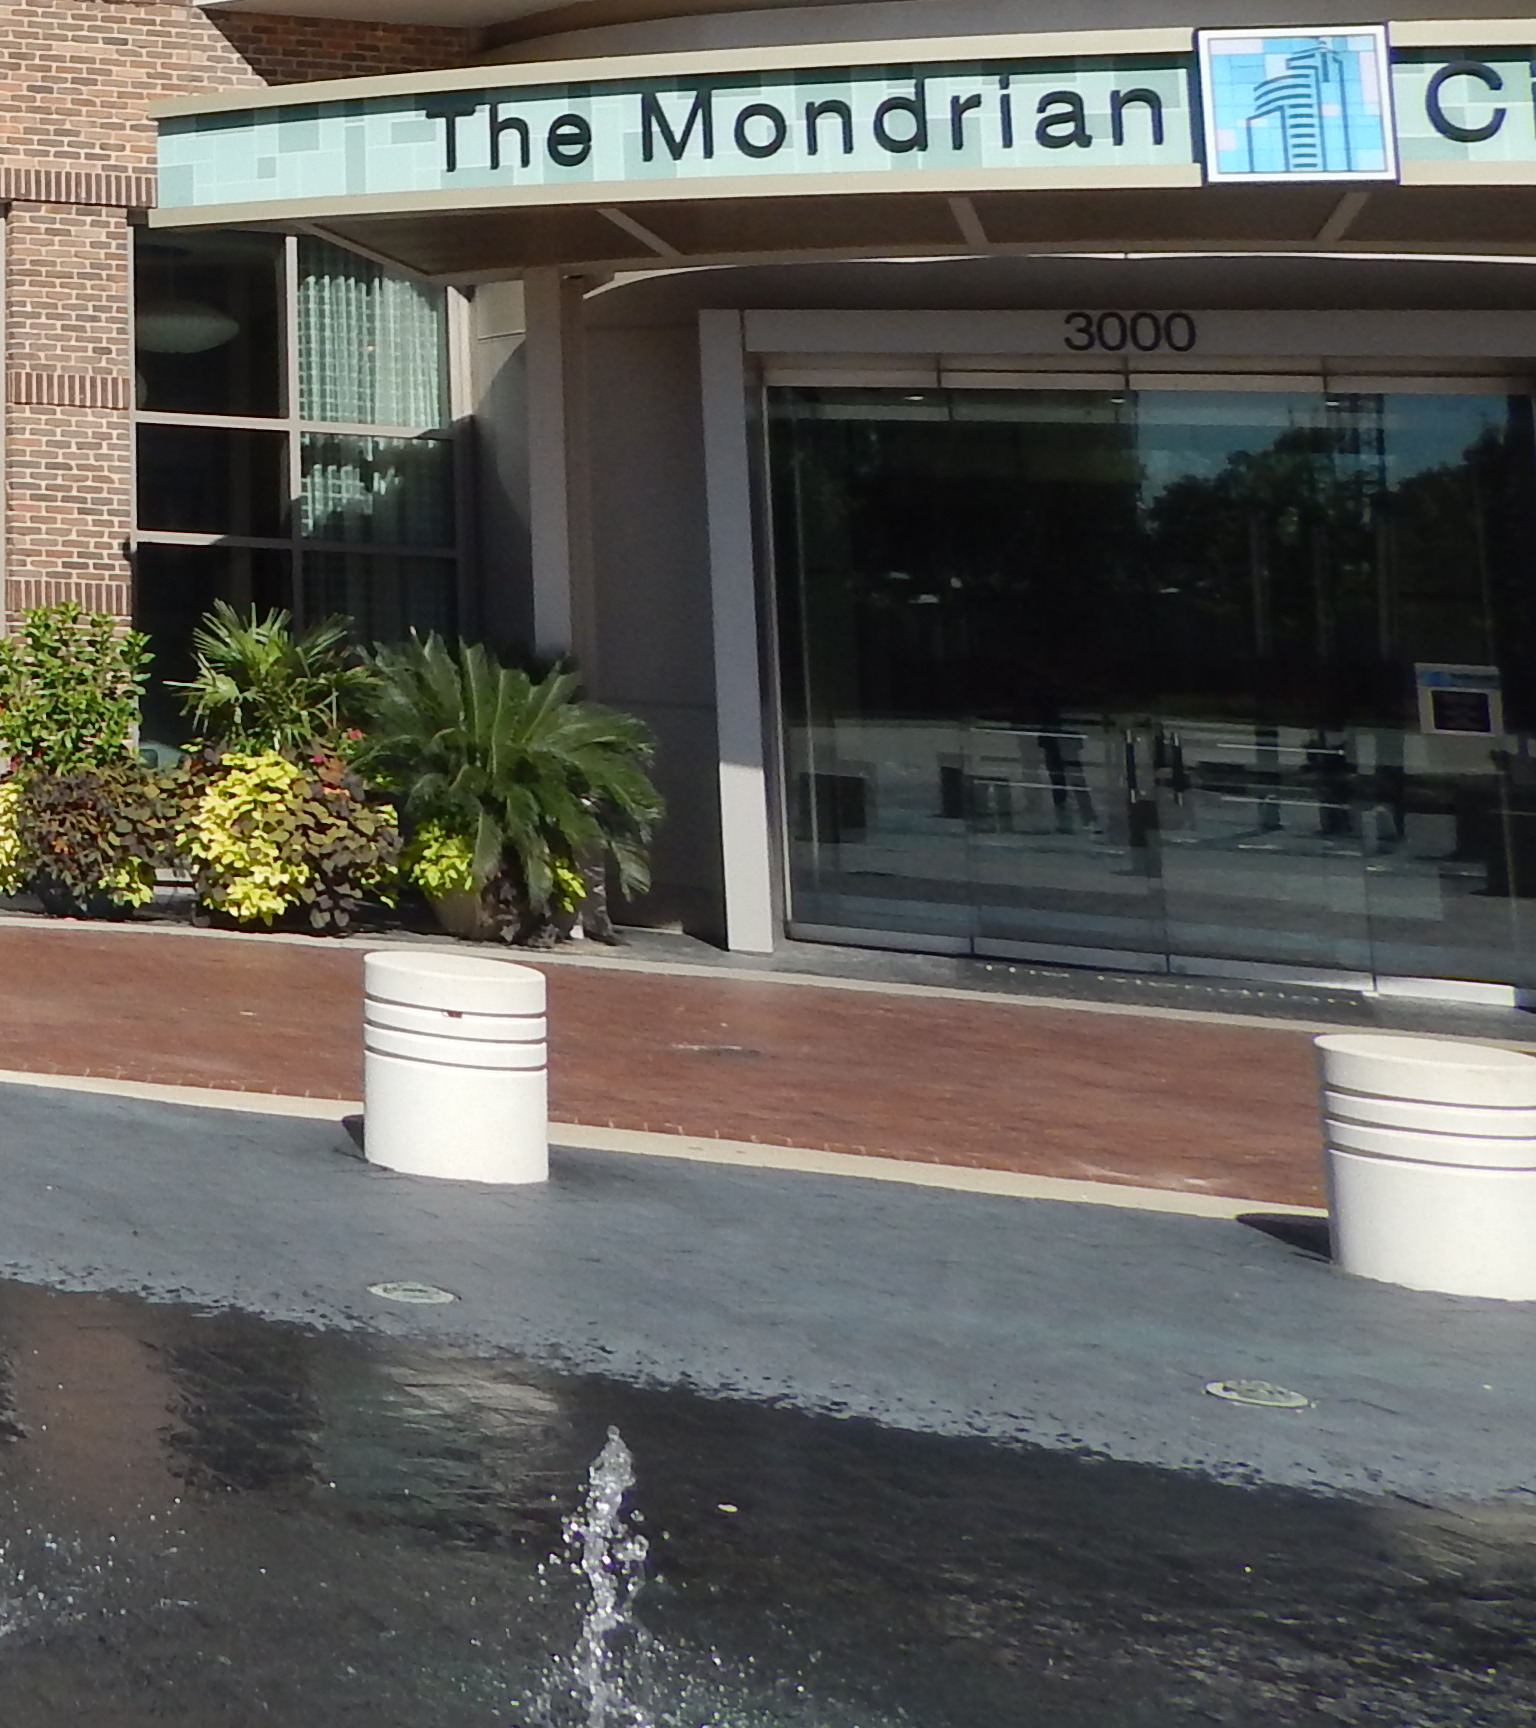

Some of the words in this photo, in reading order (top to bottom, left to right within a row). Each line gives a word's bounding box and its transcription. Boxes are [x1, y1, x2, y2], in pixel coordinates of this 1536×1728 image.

[424, 104, 593, 173] The
[639, 73, 1165, 163] Mondrian
[1063, 312, 1197, 352] 3000
